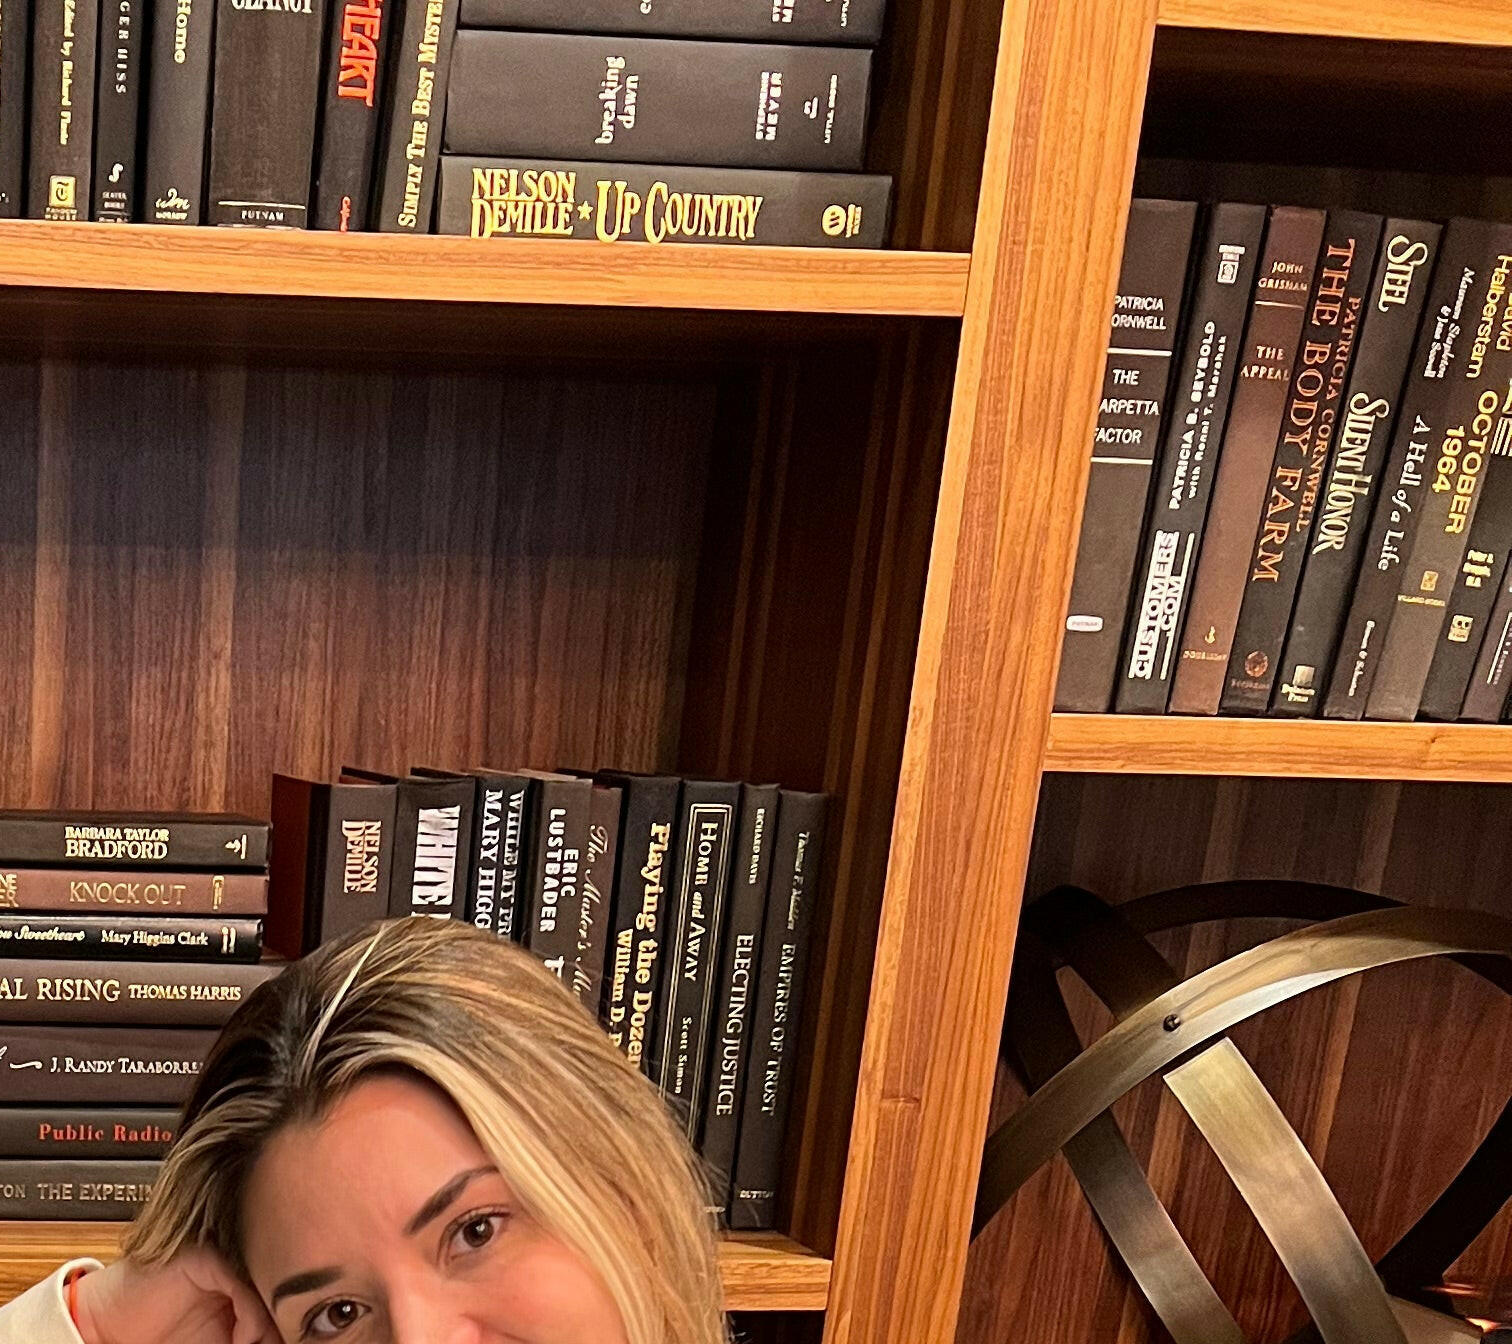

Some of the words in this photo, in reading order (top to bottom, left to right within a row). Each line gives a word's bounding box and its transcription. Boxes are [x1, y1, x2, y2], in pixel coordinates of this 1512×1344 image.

[116, 49, 128, 93] HISS
[412, 67, 435, 117] BEST
[595, 56, 626, 144] breaking
[617, 75, 638, 129] dawn
[406, 120, 429, 160] THE
[398, 163, 423, 228] SIMPLY
[472, 167, 576, 203] NELSON
[242, 211, 283, 221] PUTNAM
[644, 180, 763, 244] COUNTRY
[1258, 279, 1308, 292] GRISHAM
[1272, 261, 1304, 274] JOHN
[1312, 238, 1357, 327] THE
[1466, 255, 1512, 378] Halberstam
[1256, 345, 1284, 361] THE
[1326, 295, 1362, 401] PATRICIA
[1112, 369, 1139, 386] THE
[1241, 365, 1289, 382] APPEAL
[1283, 340, 1333, 456] BODY
[1413, 415, 1431, 435] A
[1295, 407, 1337, 532] CORNWELL
[1400, 441, 1428, 486] Hell
[1432, 426, 1466, 493] 1964
[1444, 390, 1499, 534] OCTOBER
[1252, 465, 1304, 583] FARM
[1390, 510, 1401, 523] a
[1391, 489, 1412, 513] of
[1378, 530, 1405, 570] Life
[1128, 530, 1179, 679] CUSTOMERS
[65, 840, 168, 859] BRADFORD
[480, 789, 503, 867] MARY
[360, 820, 382, 893] NELSON
[539, 808, 567, 933] LUSTBADER
[560, 848, 580, 897] ERIC
[635, 822, 671, 932] Playing
[70, 881, 140, 904] KNOCK
[143, 884, 186, 906] OUT
[101, 930, 131, 945] Mary
[133, 931, 175, 947] Higgins
[177, 932, 209, 946] Clark
[635, 937, 659, 985] the
[36, 978, 121, 1001] RISING
[128, 984, 187, 999] THOMAS
[190, 985, 241, 1001] HARRIS
[727, 933, 755, 1034] ELECTING
[50, 1057, 61, 1073] J.
[64, 1056, 115, 1074] RANDY
[716, 1037, 741, 1116] JUSTICE
[39, 1123, 104, 1141] Public
[114, 1124, 172, 1143] Radio
[37, 1183, 73, 1201] THE
